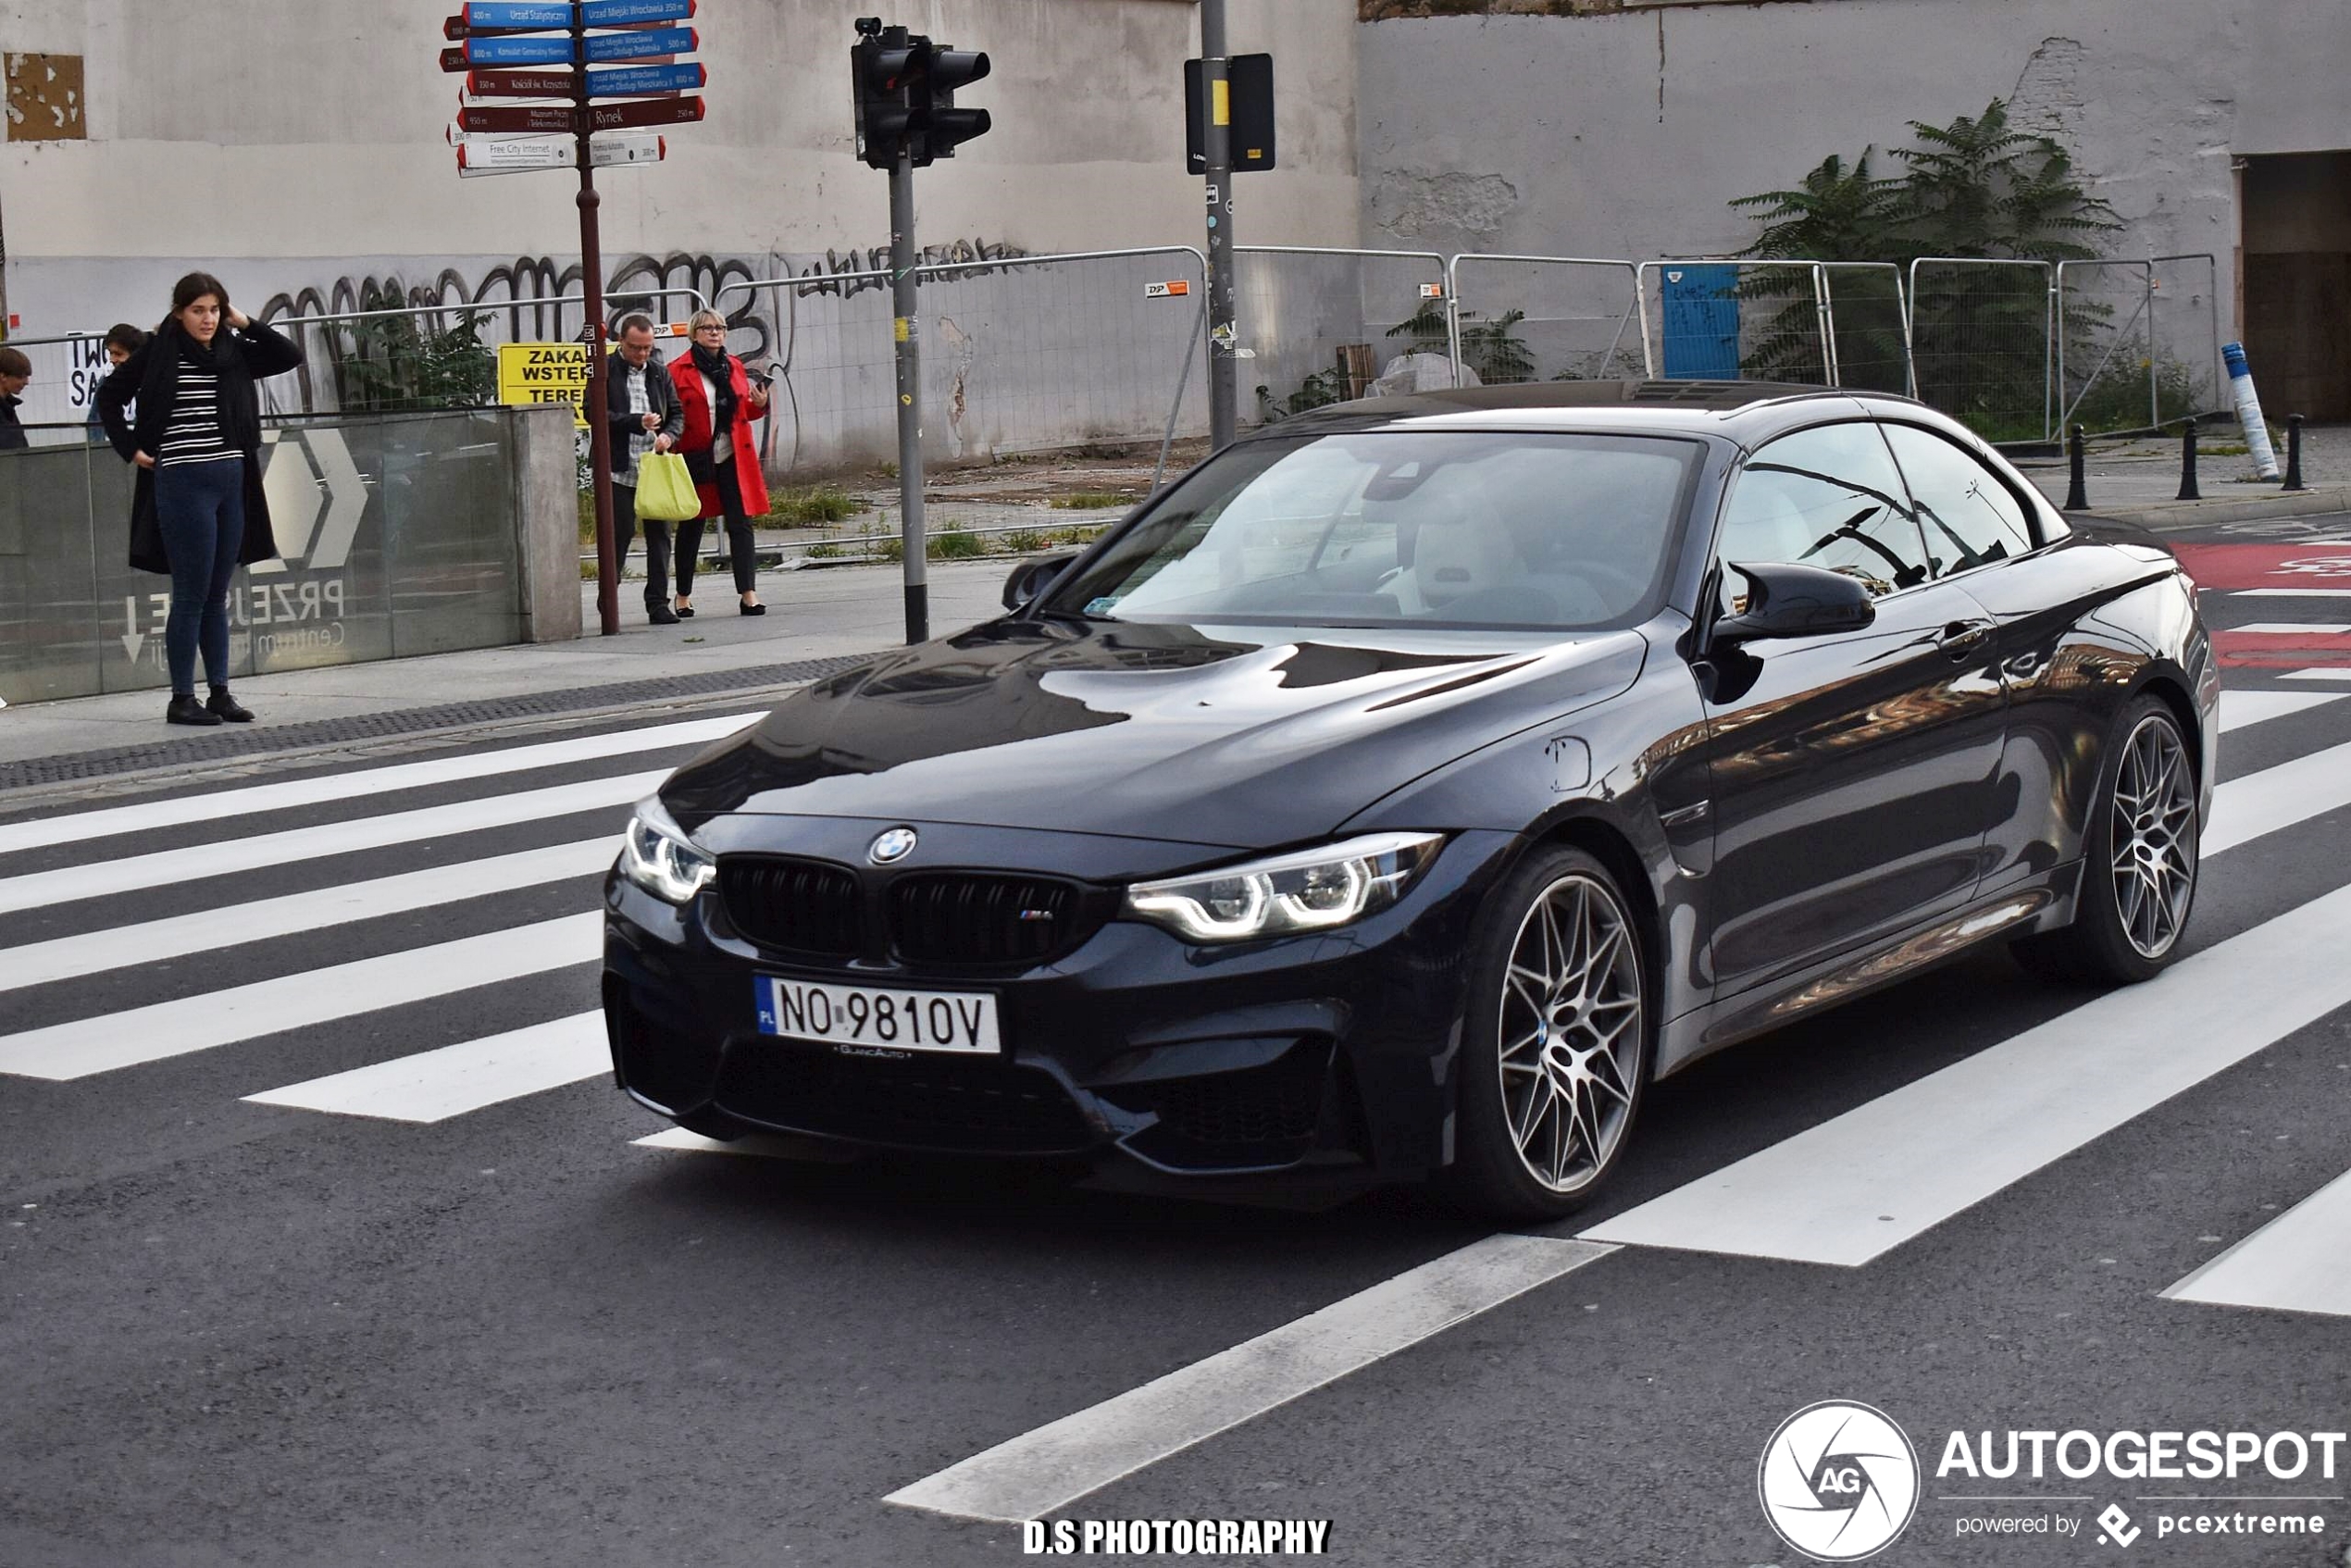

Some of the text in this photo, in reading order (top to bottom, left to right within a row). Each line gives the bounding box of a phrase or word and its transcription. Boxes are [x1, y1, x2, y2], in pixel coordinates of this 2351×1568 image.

[595, 108, 624, 128] Rynek
[490, 144, 551, 156] Free City Internet
[1149, 284, 1164, 294] DP
[529, 350, 585, 365] ZAKA
[529, 388, 586, 404] TERE
[760, 1011, 774, 1024] PL
[780, 983, 981, 1047] NO 9810V
